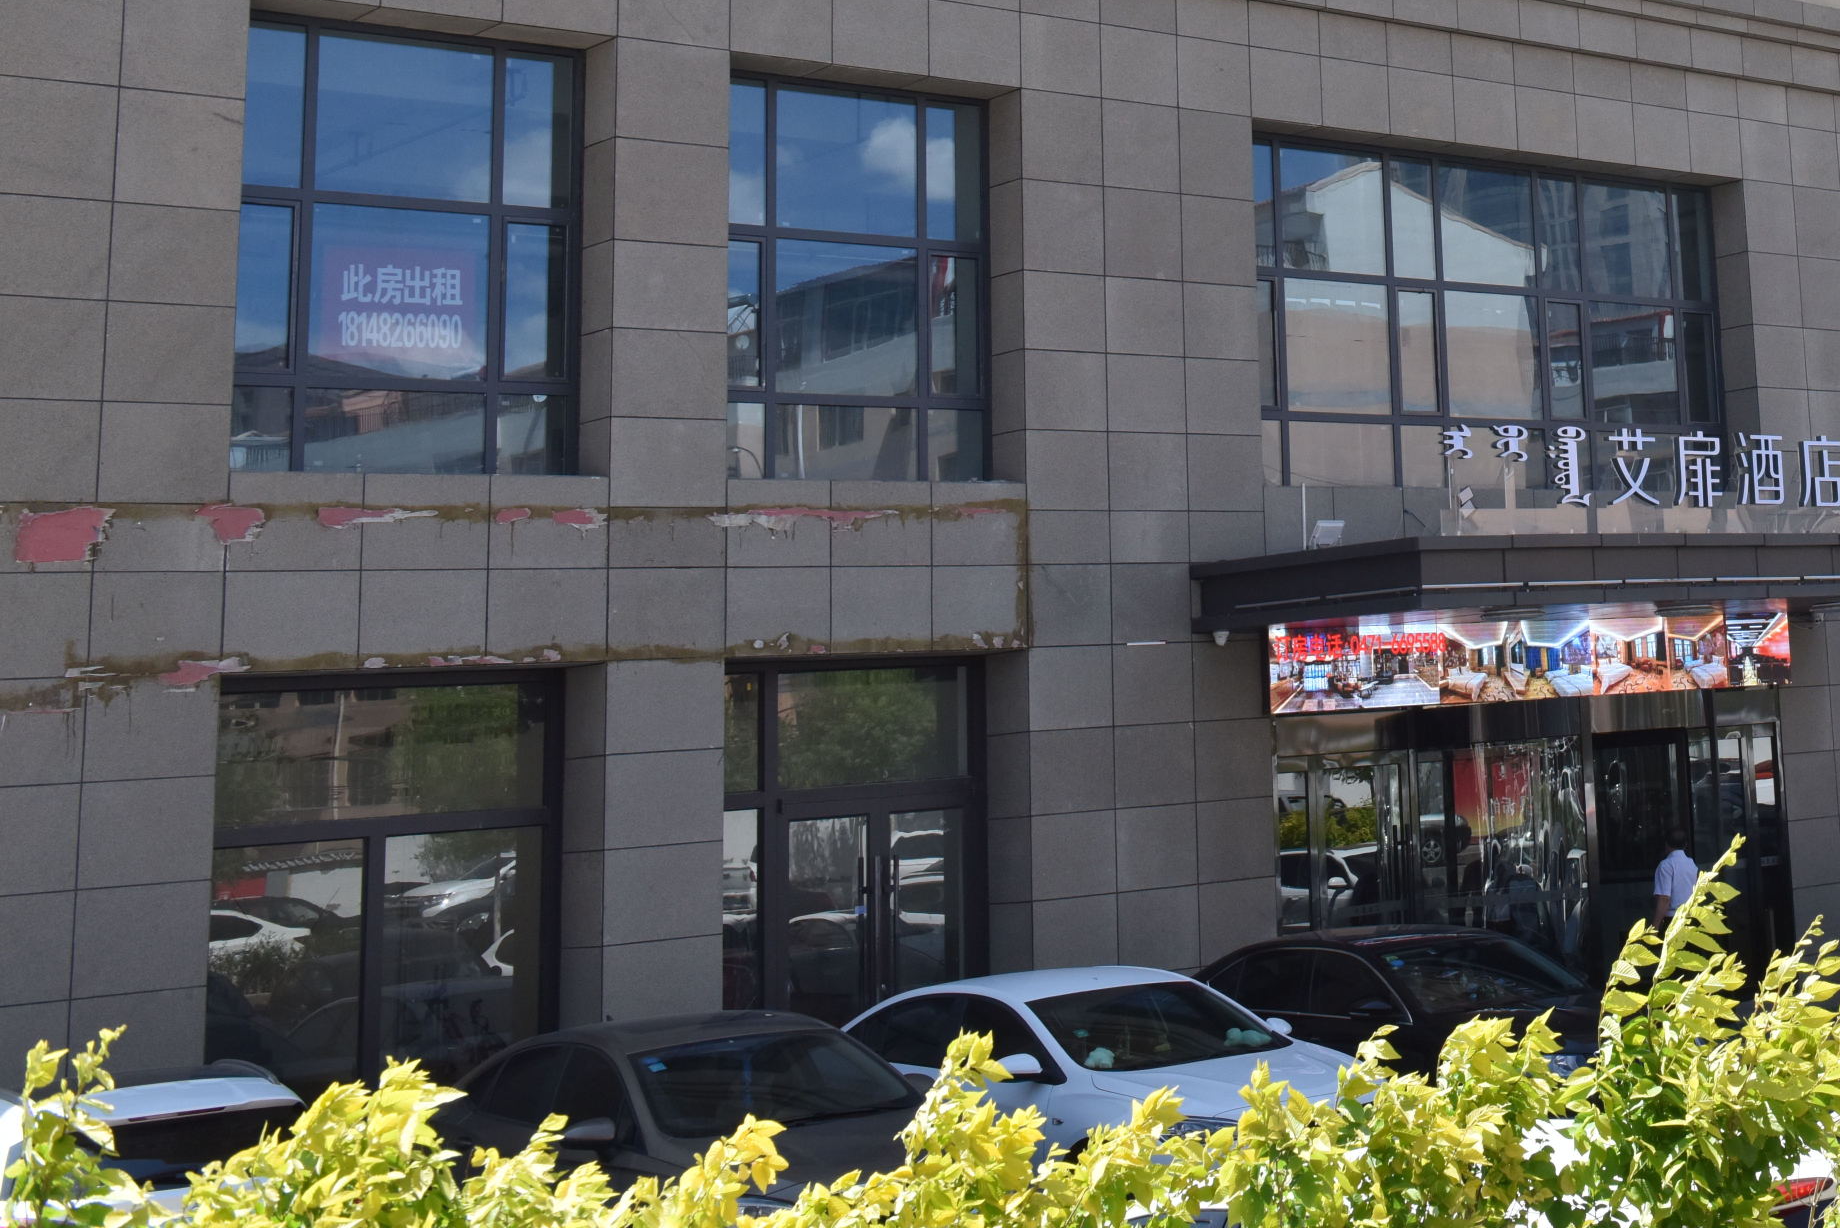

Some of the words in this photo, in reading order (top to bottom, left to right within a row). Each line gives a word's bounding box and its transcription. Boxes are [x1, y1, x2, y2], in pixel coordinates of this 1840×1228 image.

[340, 263, 464, 306] 此房出租
[338, 310, 463, 349] 18148266090
